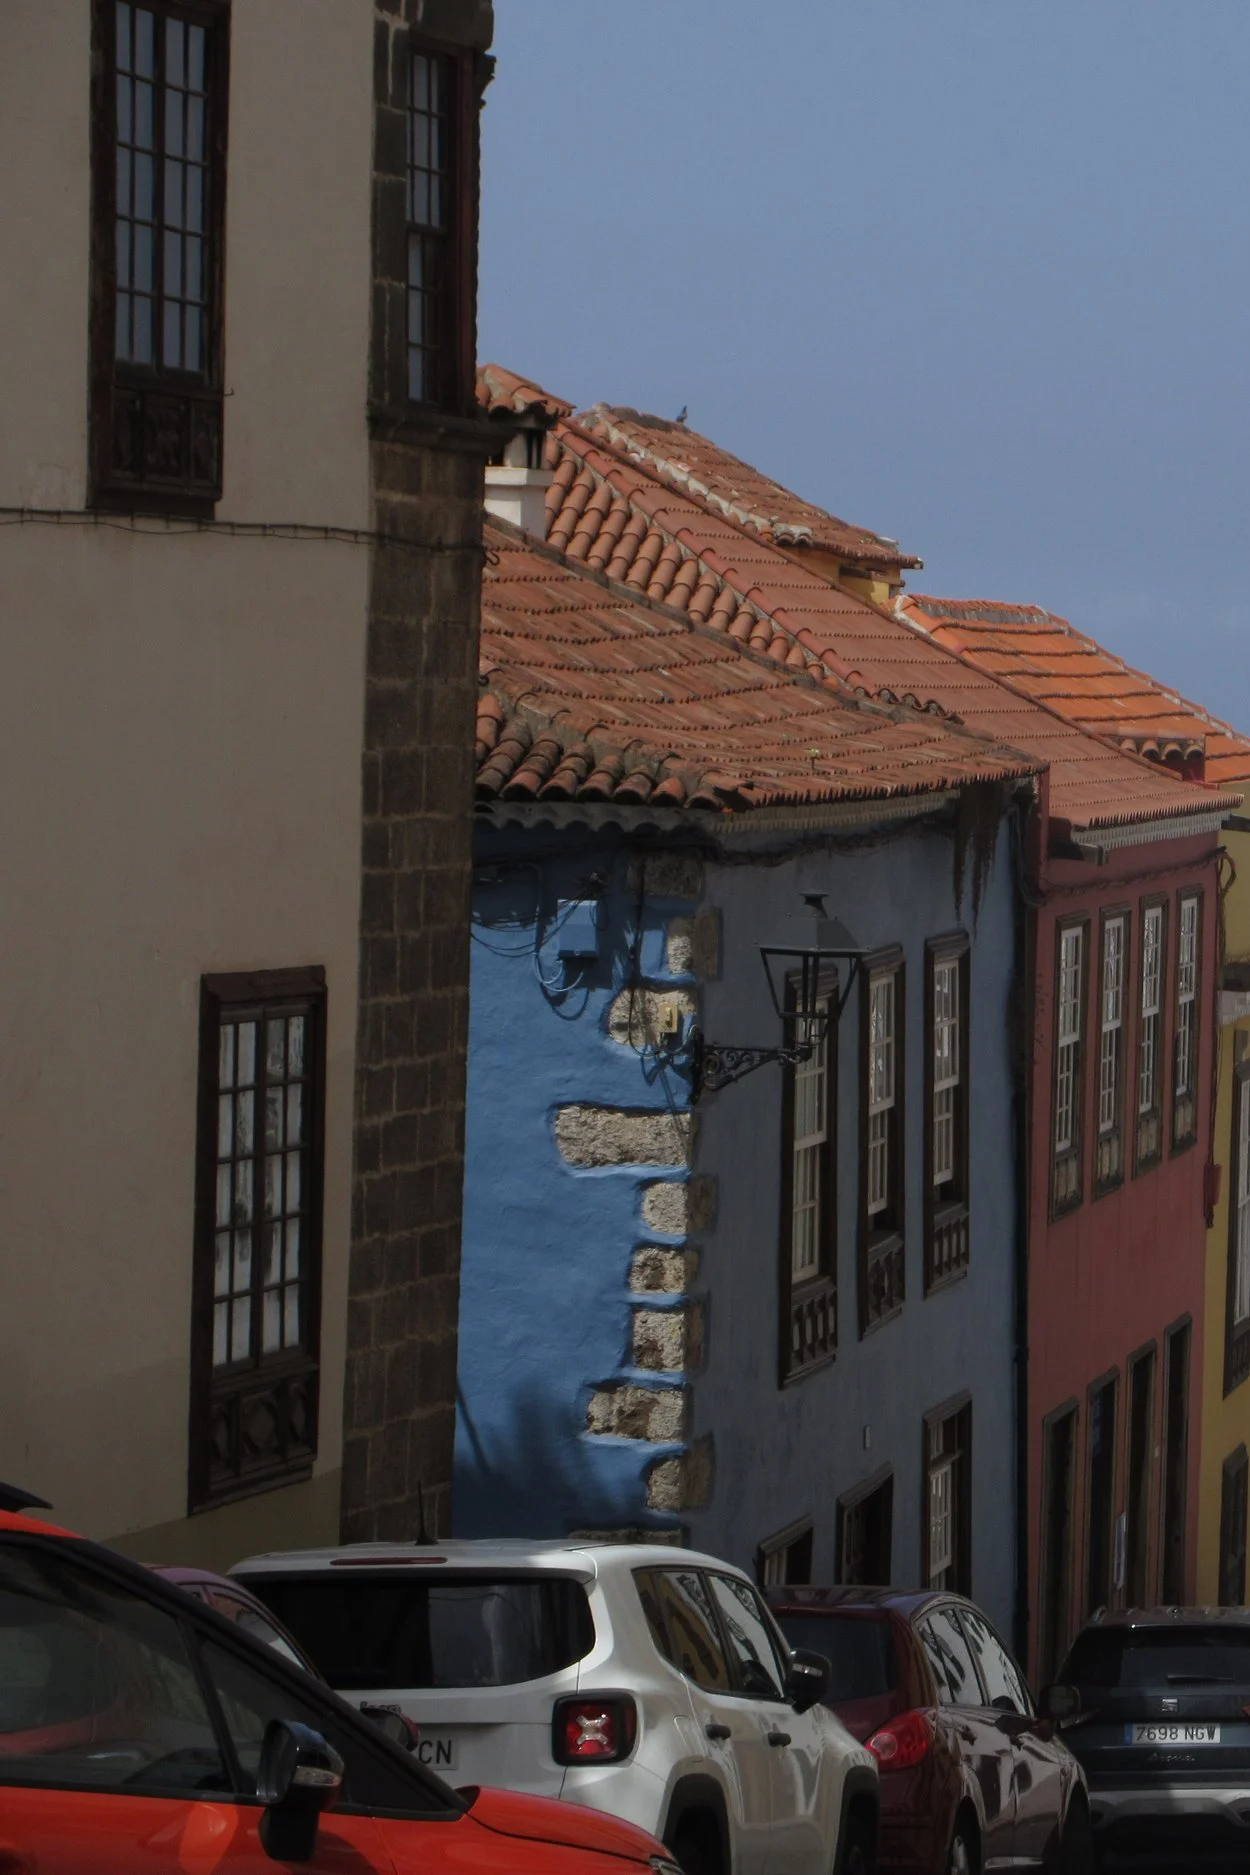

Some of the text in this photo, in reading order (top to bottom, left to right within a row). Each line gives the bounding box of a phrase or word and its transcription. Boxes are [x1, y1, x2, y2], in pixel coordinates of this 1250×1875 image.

[1136, 1726, 1216, 1741] 7698 NGW
[419, 1739, 452, 1764] CN
